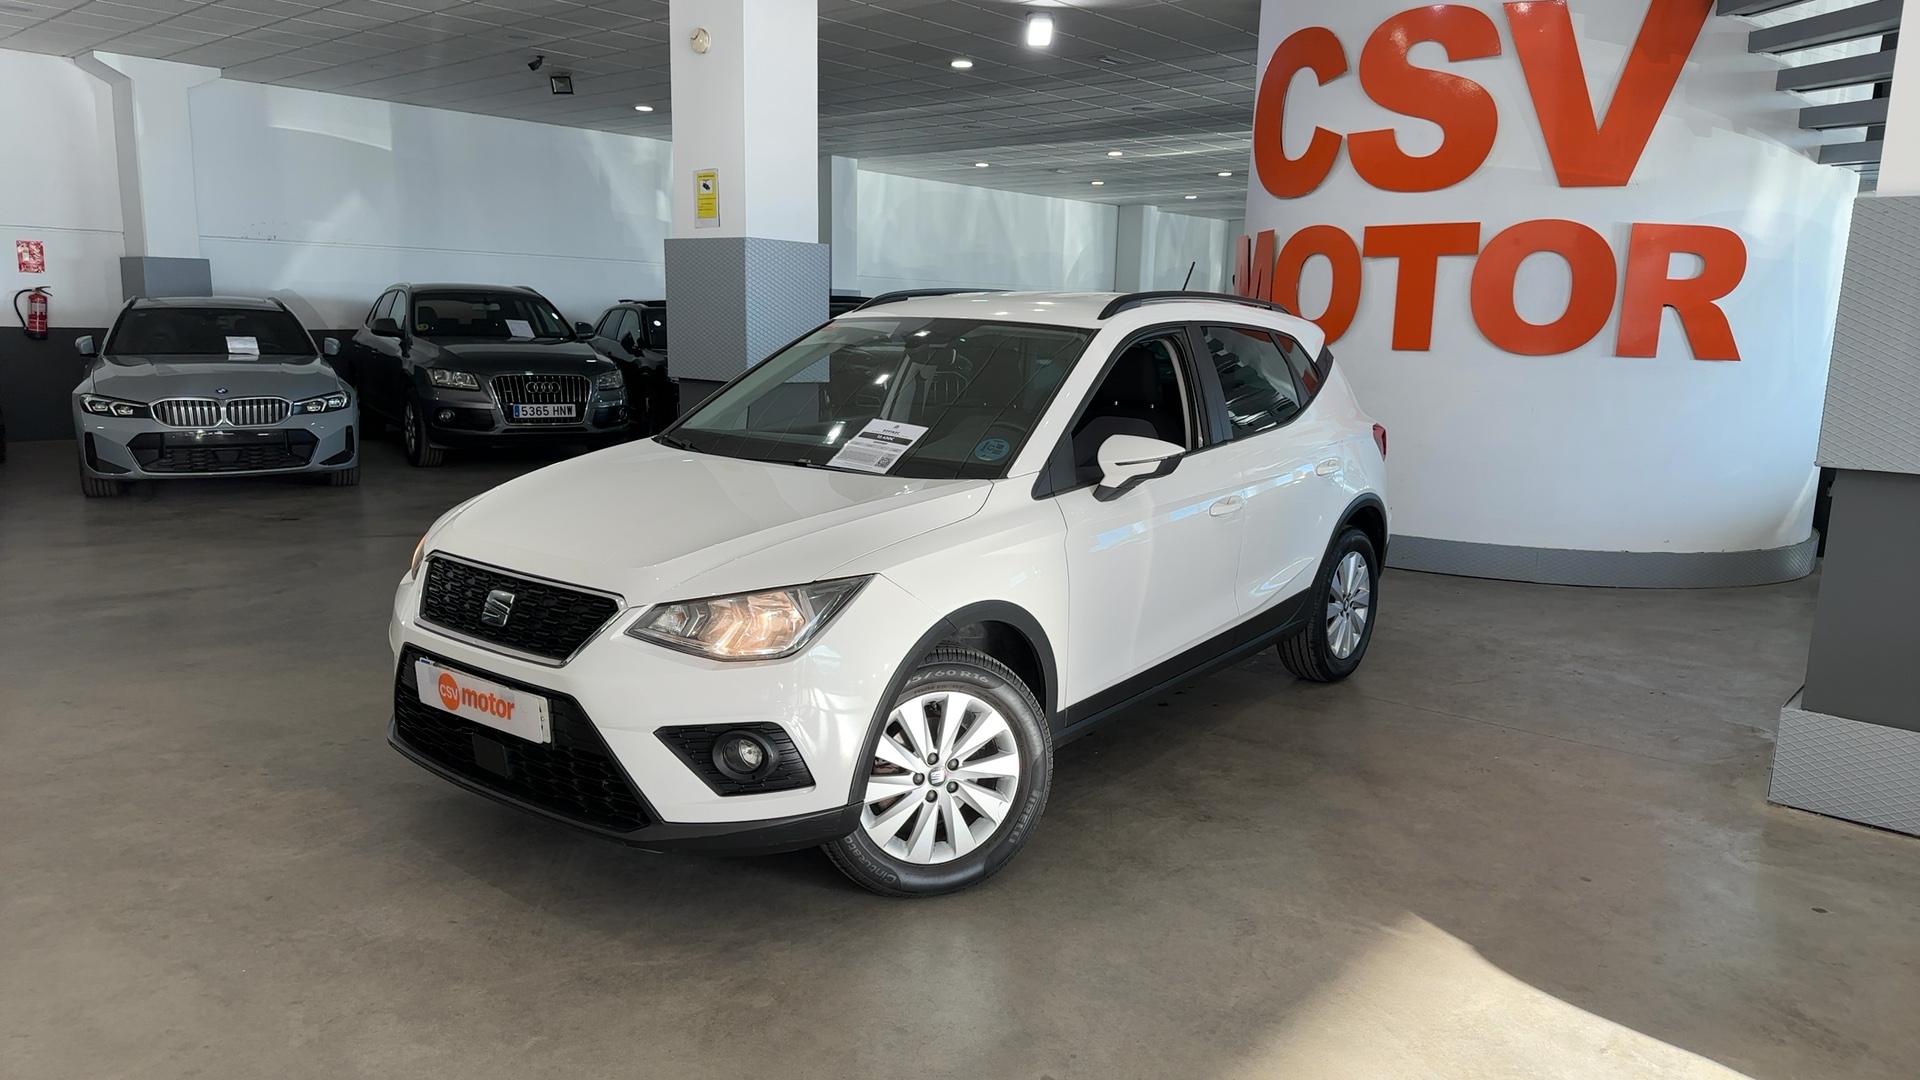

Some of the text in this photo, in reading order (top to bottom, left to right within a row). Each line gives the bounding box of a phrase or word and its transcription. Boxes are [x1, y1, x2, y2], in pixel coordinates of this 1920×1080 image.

[1253, 0, 1713, 199] CSV
[1235, 218, 1747, 361] MOTOR
[521, 405, 573, 417] 5365 HNW
[439, 684, 459, 701] CSV
[960, 670, 989, 683] R16
[461, 687, 515, 720] motor
[843, 835, 898, 885] Cinturato
